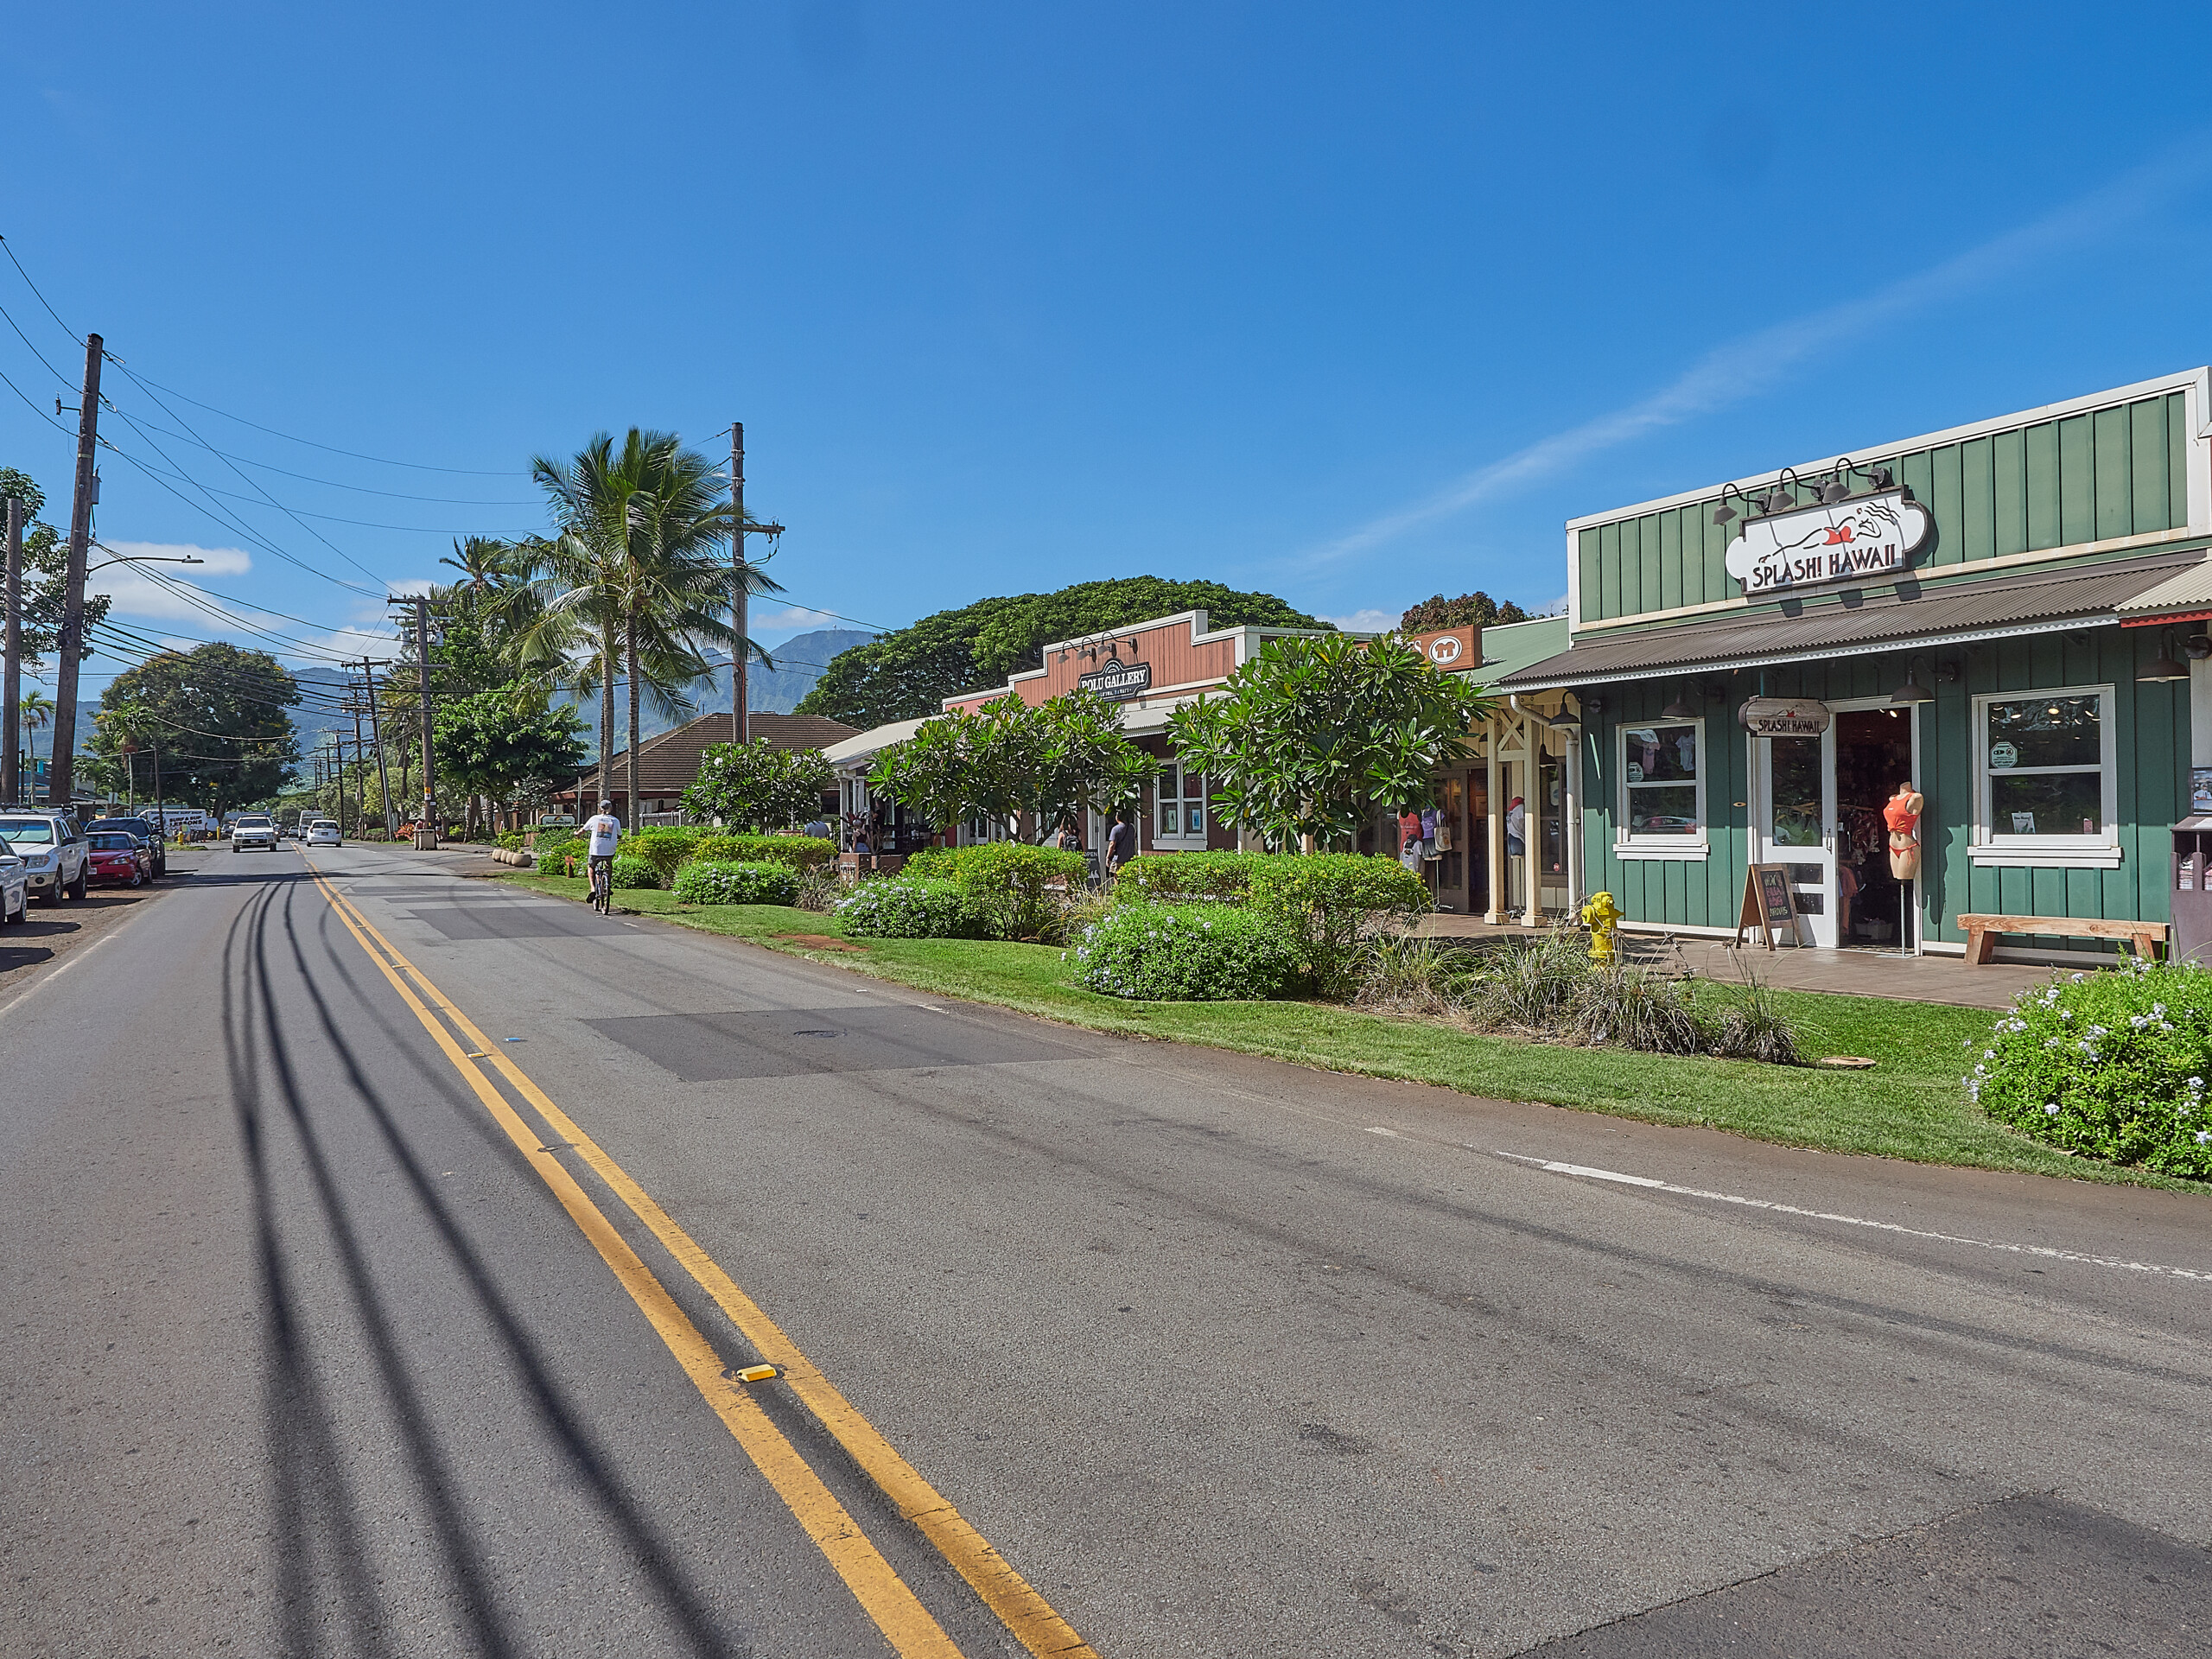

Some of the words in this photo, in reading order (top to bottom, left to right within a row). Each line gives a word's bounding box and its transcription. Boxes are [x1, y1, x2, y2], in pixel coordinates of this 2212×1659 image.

[1752, 556, 1822, 588] SPLASH!
[1828, 543, 1896, 575] HAWAII
[1104, 669, 1147, 689] GALLERY
[1758, 719, 1790, 732] SPLASH!
[1792, 720, 1820, 733] HAWAII
